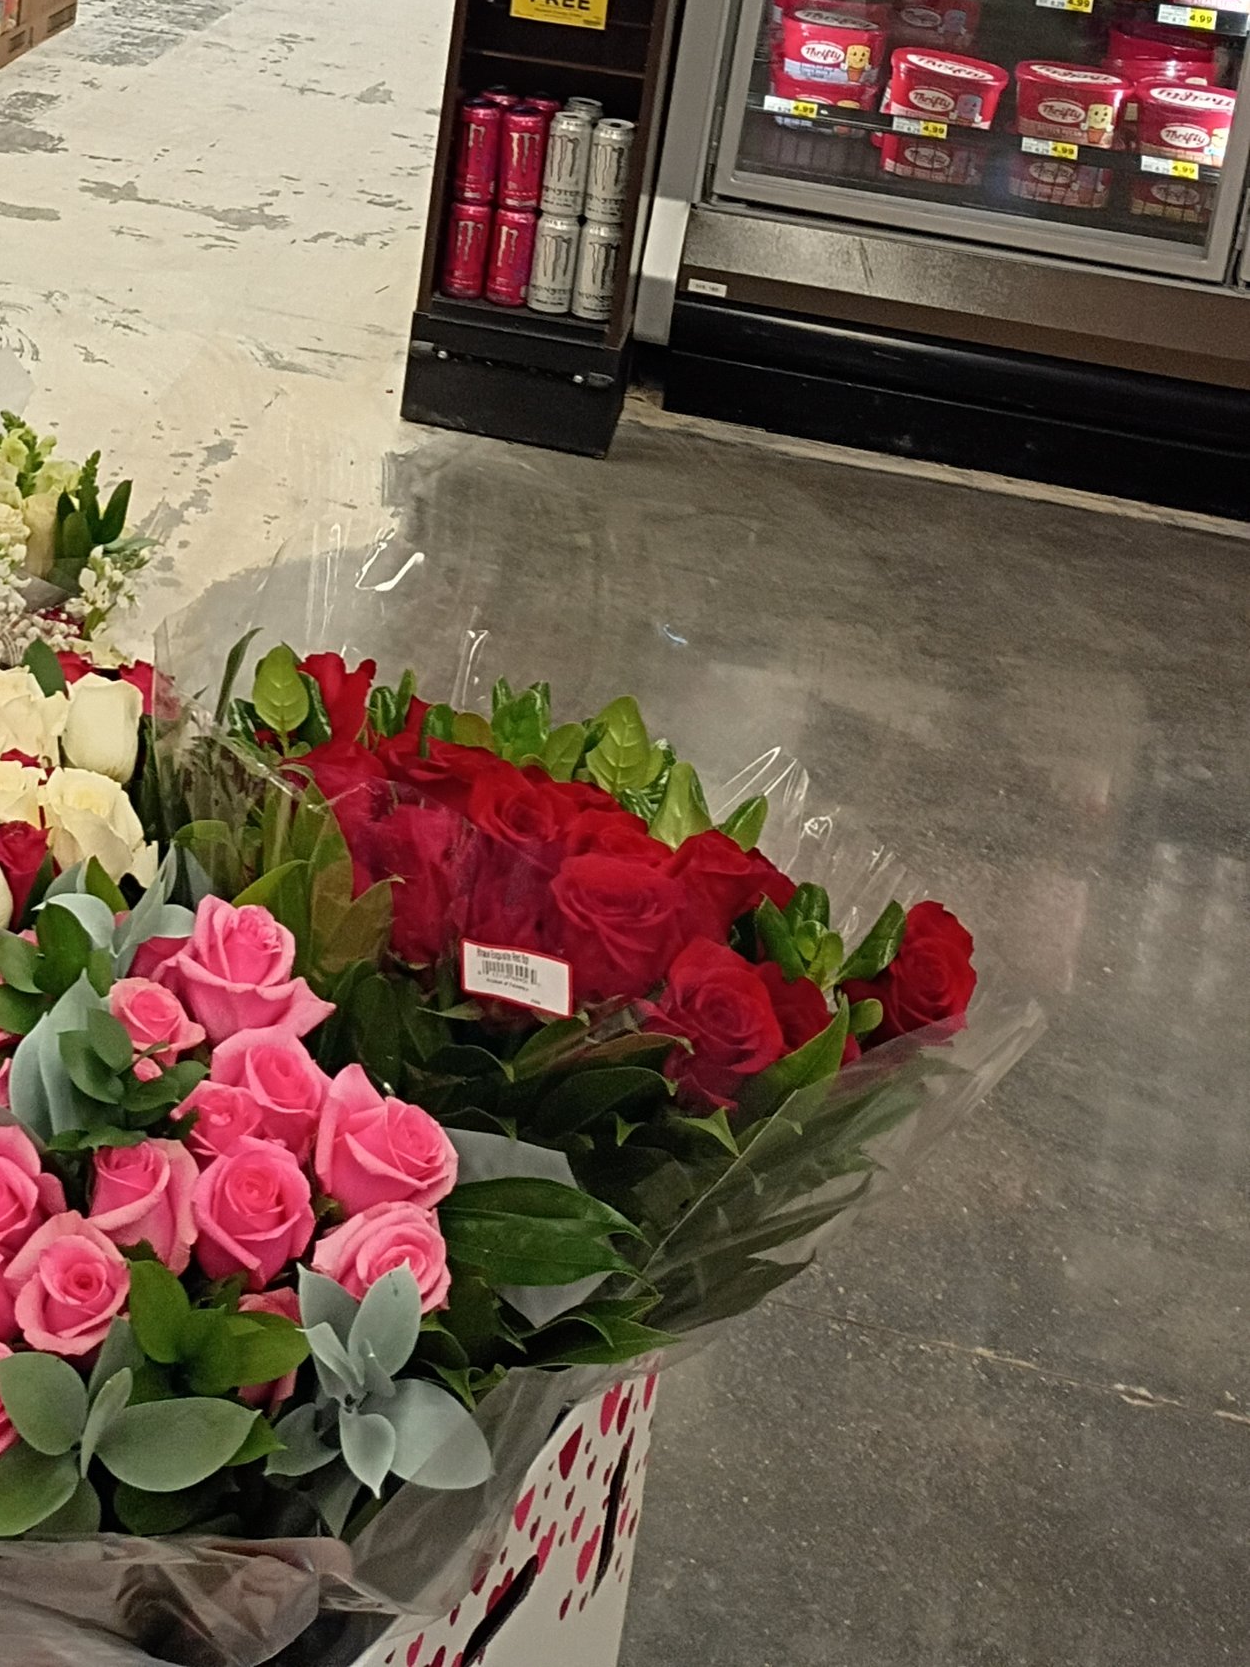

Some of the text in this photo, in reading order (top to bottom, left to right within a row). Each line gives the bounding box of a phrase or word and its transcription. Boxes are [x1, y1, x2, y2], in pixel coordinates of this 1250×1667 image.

[1189, 14, 1212, 24] 4.99
[805, 46, 842, 63] Thrifty
[913, 91, 951, 108] Thrifty
[793, 105, 815, 114] 4.99
[1040, 102, 1082, 120] Thrifty
[922, 124, 945, 134] 4.99
[1164, 127, 1207, 146] Thrifty
[1051, 145, 1075, 155] 4.99
[1171, 163, 1196, 174] 4.99
